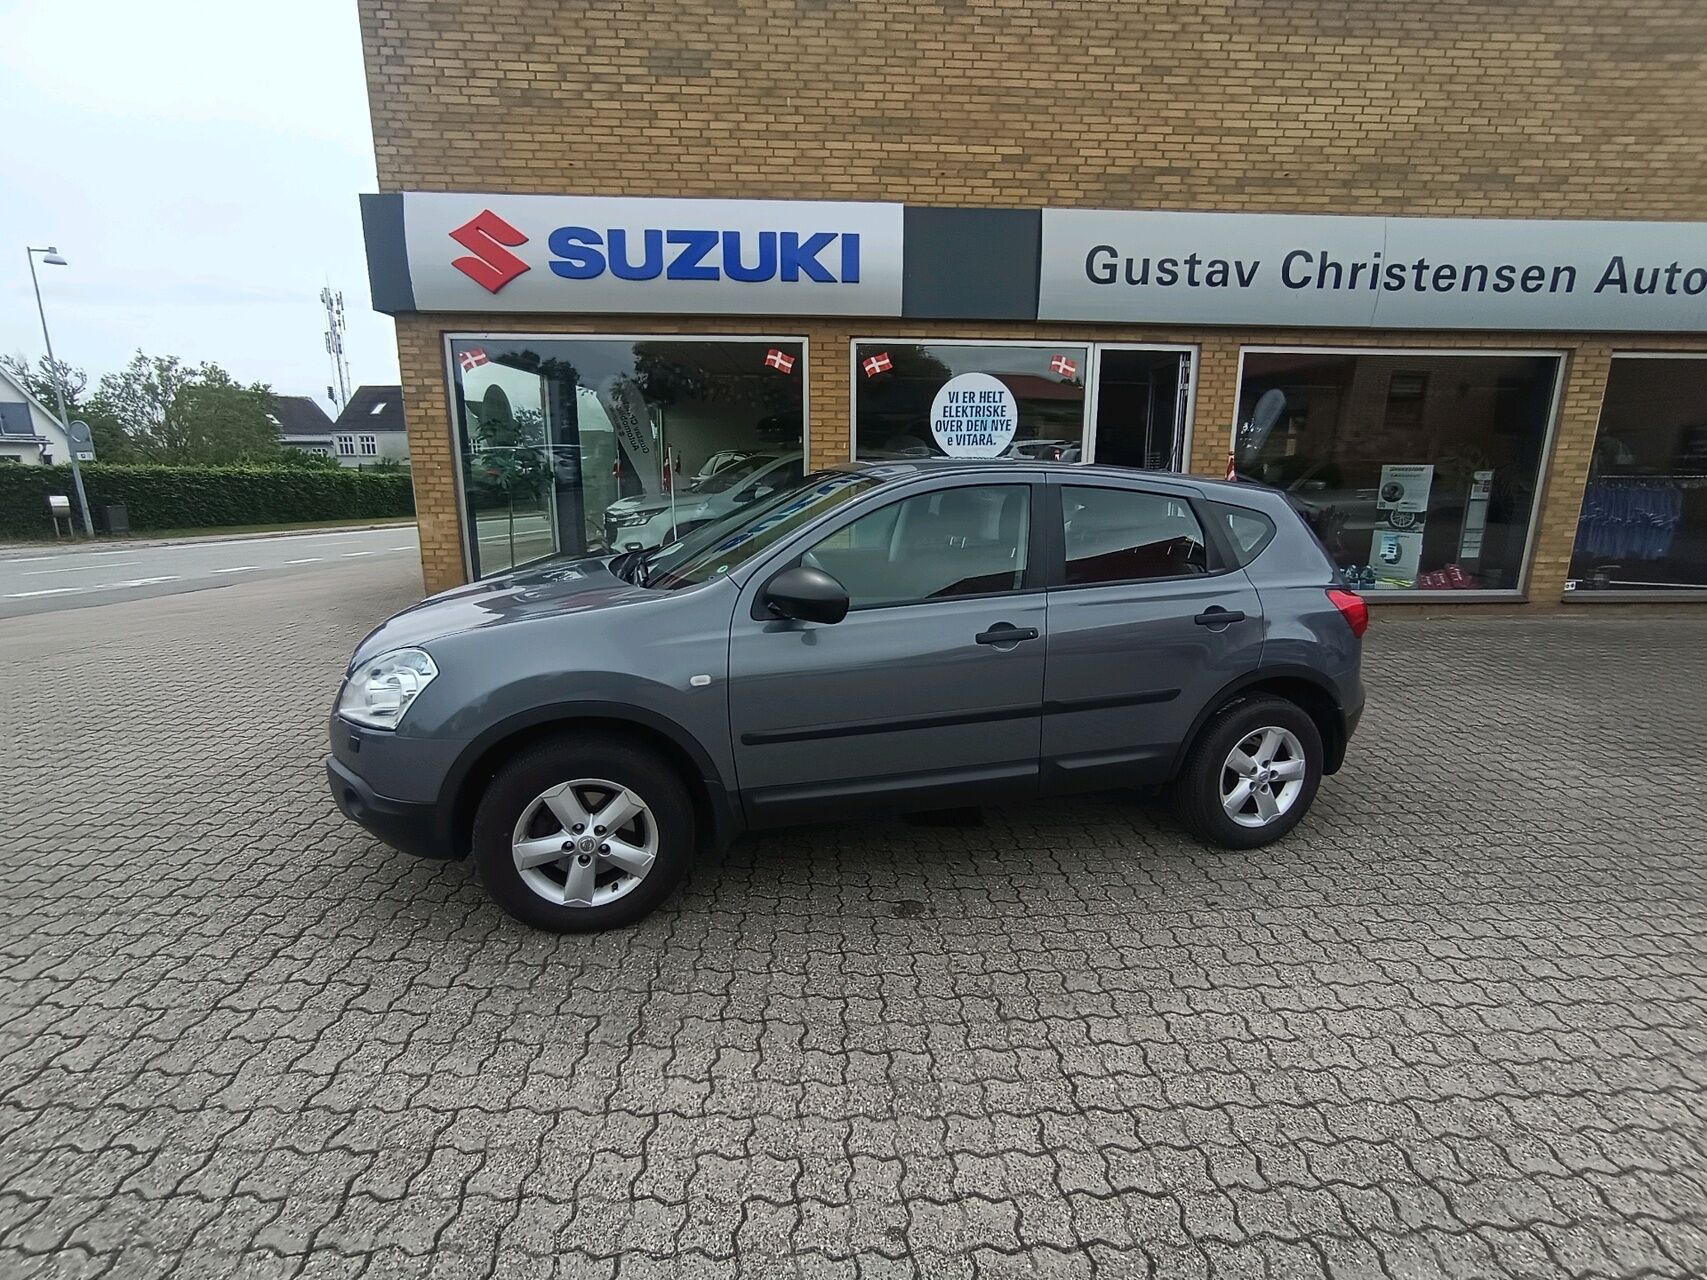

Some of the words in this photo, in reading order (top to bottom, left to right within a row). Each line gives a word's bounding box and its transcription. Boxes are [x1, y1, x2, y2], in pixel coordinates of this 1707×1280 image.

[548, 226, 860, 284] SUZUKI
[1085, 244, 1261, 288] Gustav
[1281, 249, 1577, 296] Christensen
[1593, 255, 1707, 296] Auto
[948, 391, 959, 404] VI
[962, 391, 976, 404] ER
[979, 391, 1004, 404] HELT
[943, 405, 1007, 418] ELEKTRISKE
[935, 419, 963, 432] OVER
[966, 419, 988, 432] DEN
[990, 419, 1012, 432] NYE
[947, 436, 953, 446] e
[955, 433, 997, 446] VITARA.
